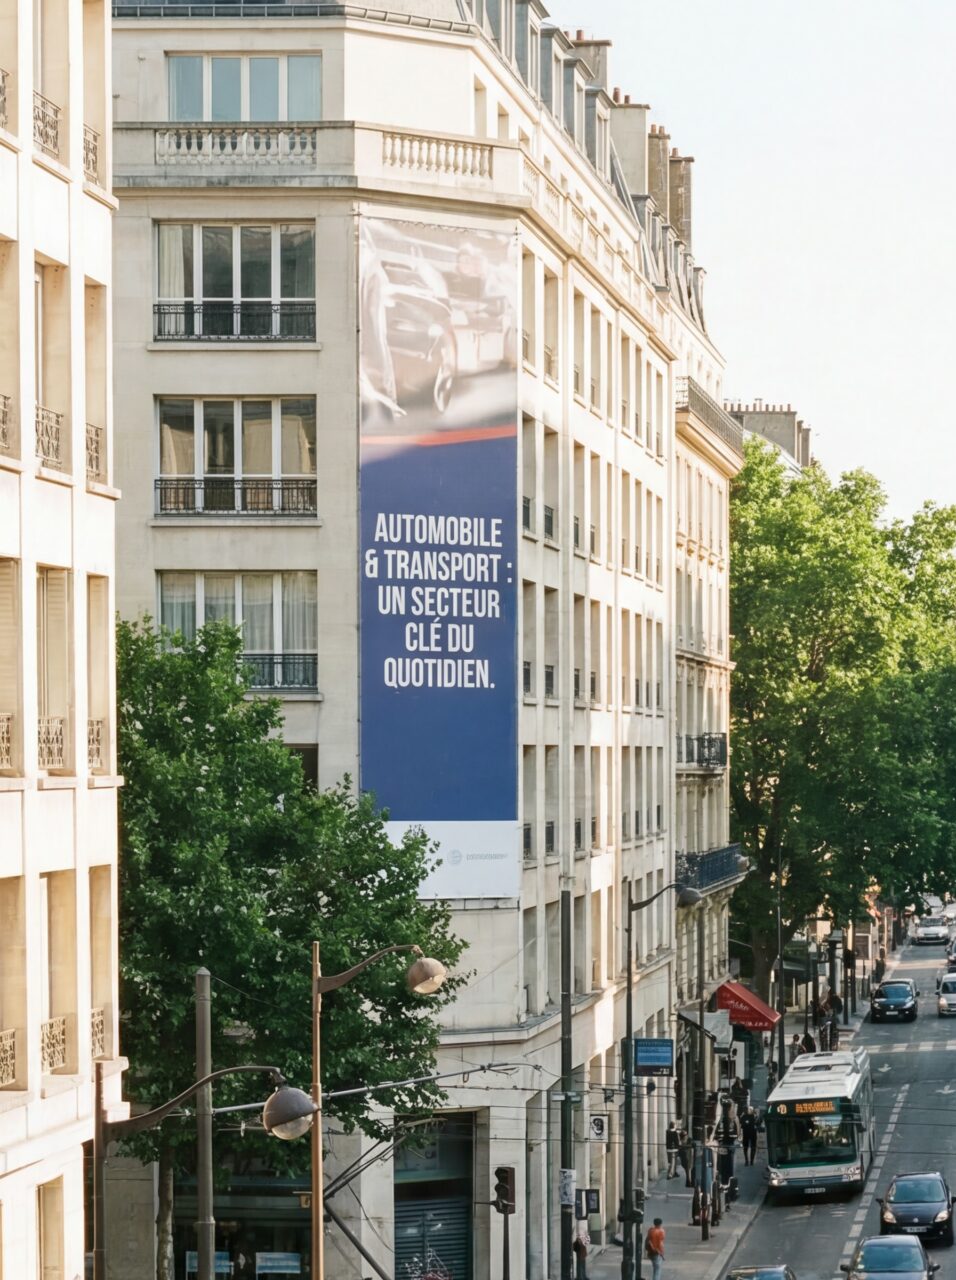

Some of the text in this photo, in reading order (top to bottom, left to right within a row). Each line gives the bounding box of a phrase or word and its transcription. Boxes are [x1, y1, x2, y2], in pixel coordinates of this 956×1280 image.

[374, 513, 502, 548] AUTOMOBILE
[365, 549, 513, 584] & TRANSPORT :
[378, 585, 500, 618] UN SECTEUR
[405, 617, 474, 652] CLÉ DU
[384, 657, 496, 689] QUOTIDIEN.
